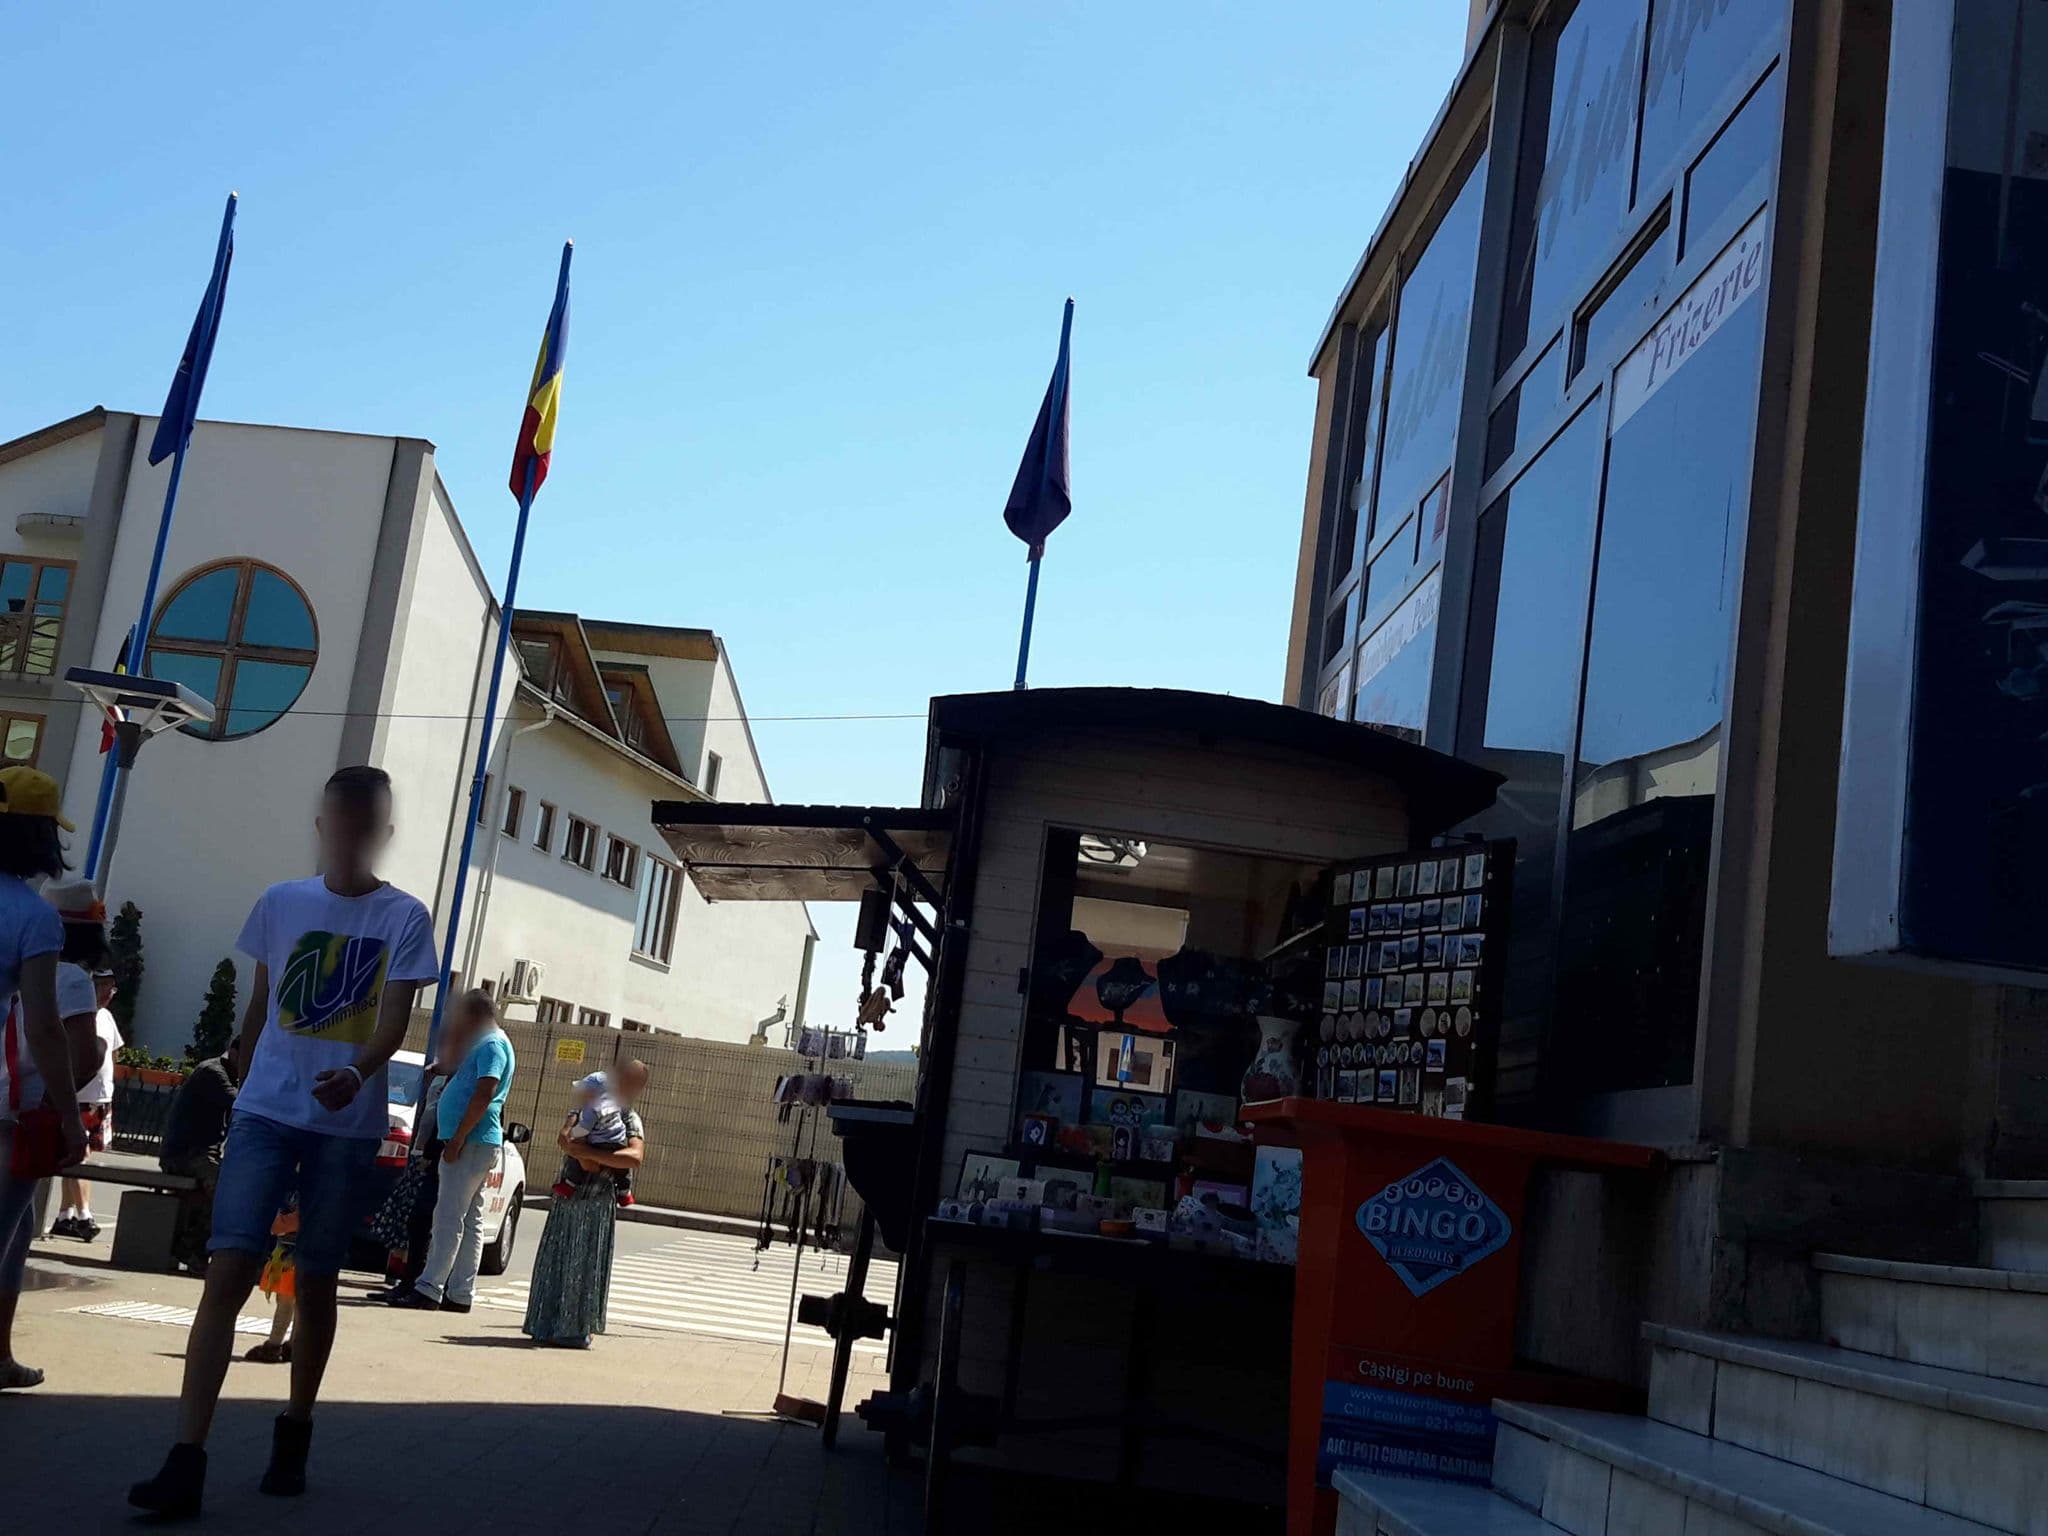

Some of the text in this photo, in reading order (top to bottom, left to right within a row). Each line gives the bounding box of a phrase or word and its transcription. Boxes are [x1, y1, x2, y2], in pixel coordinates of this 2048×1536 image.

[1645, 240, 1763, 391] Frizerie
[1385, 1177, 1483, 1211] SUPER
[1365, 1203, 1487, 1243] BINGO
[1412, 1370, 1433, 1387] pe
[1437, 1370, 1475, 1392] bune
